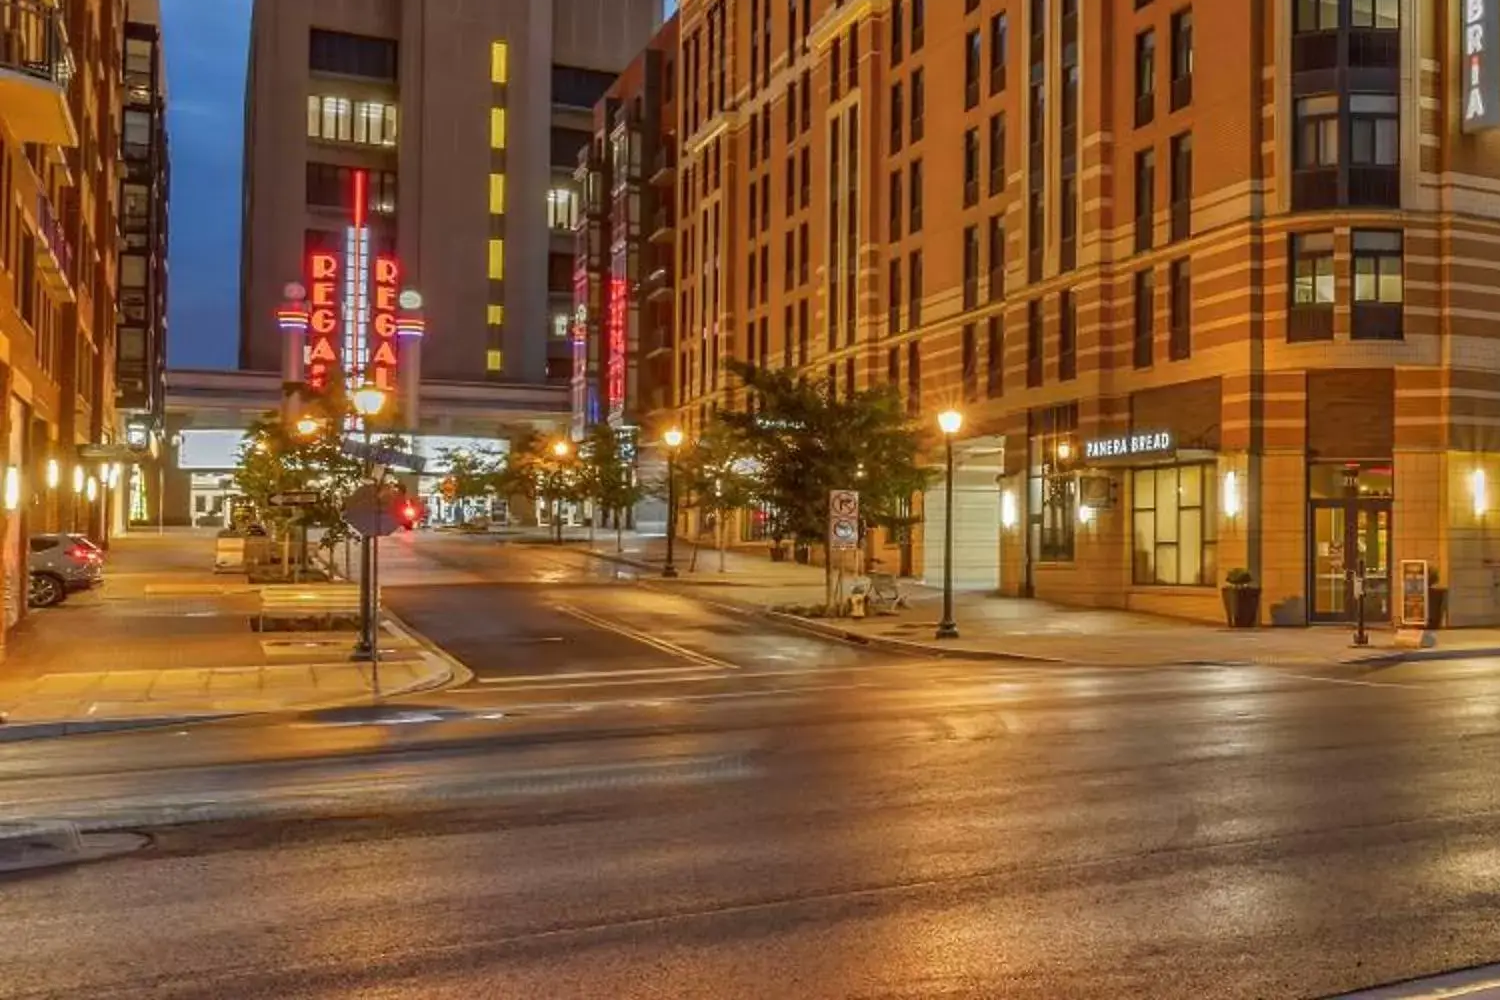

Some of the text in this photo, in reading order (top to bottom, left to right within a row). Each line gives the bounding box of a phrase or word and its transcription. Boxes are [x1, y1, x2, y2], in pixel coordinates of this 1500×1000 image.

[374, 258, 398, 391] REGAL
[1086, 432, 1169, 456] PANERA BREAD
